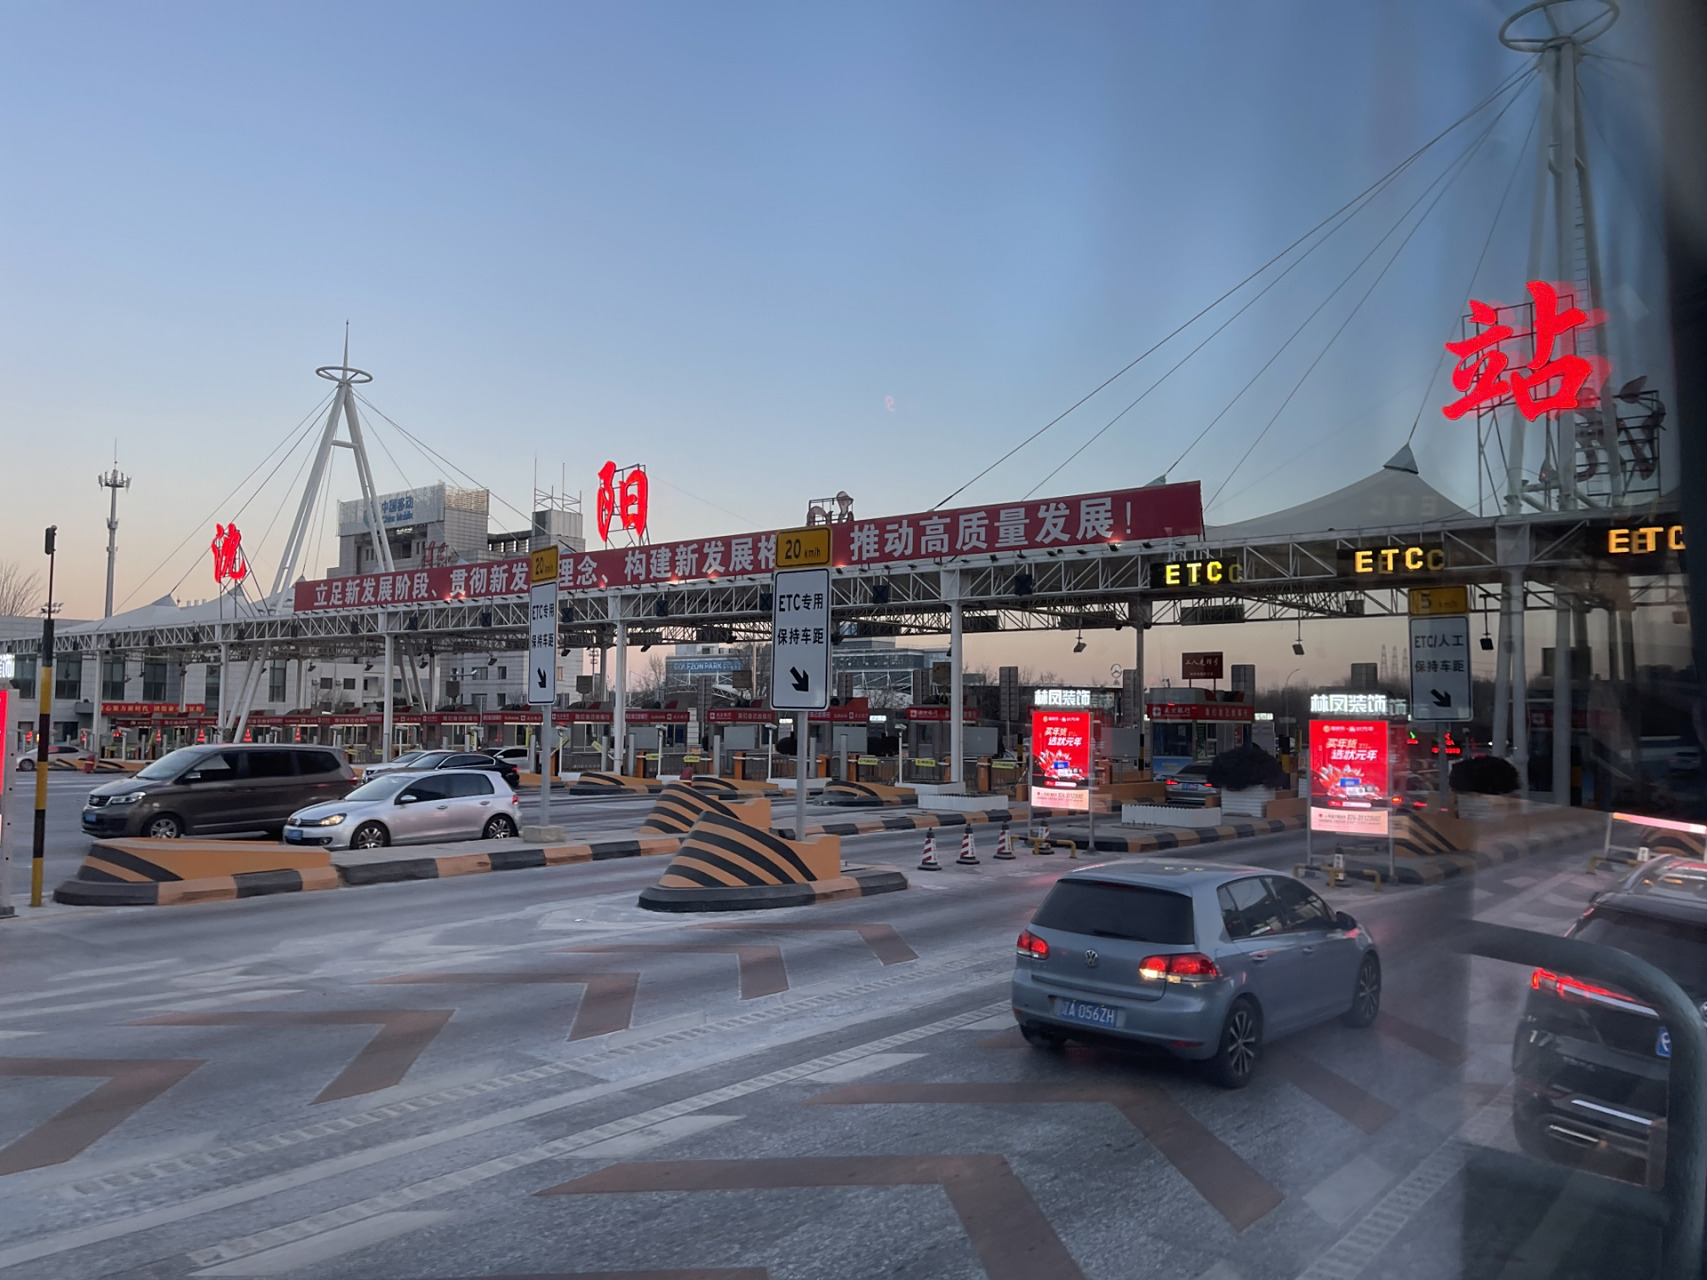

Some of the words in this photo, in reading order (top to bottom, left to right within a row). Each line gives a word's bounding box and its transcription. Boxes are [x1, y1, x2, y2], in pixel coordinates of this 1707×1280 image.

[1441, 279, 1593, 423] 站
[597, 460, 649, 543] 阳
[785, 538, 801, 560] 20
[535, 556, 545, 575] 20
[1354, 546, 1424, 573] ETC
[1165, 559, 1223, 586] ETC
[778, 593, 824, 612] ETC专用
[1420, 593, 1432, 609] 5
[532, 602, 555, 620] ETC专用
[531, 632, 554, 649] 保持车距
[777, 627, 825, 646] 保持车距
[1414, 633, 1464, 649] ETC/人工
[704, 660, 722, 670] PARK
[1414, 659, 1466, 673] 保持车距
[1034, 689, 1091, 706] 林凤装饰
[1310, 693, 1387, 713] 林凤装饰
